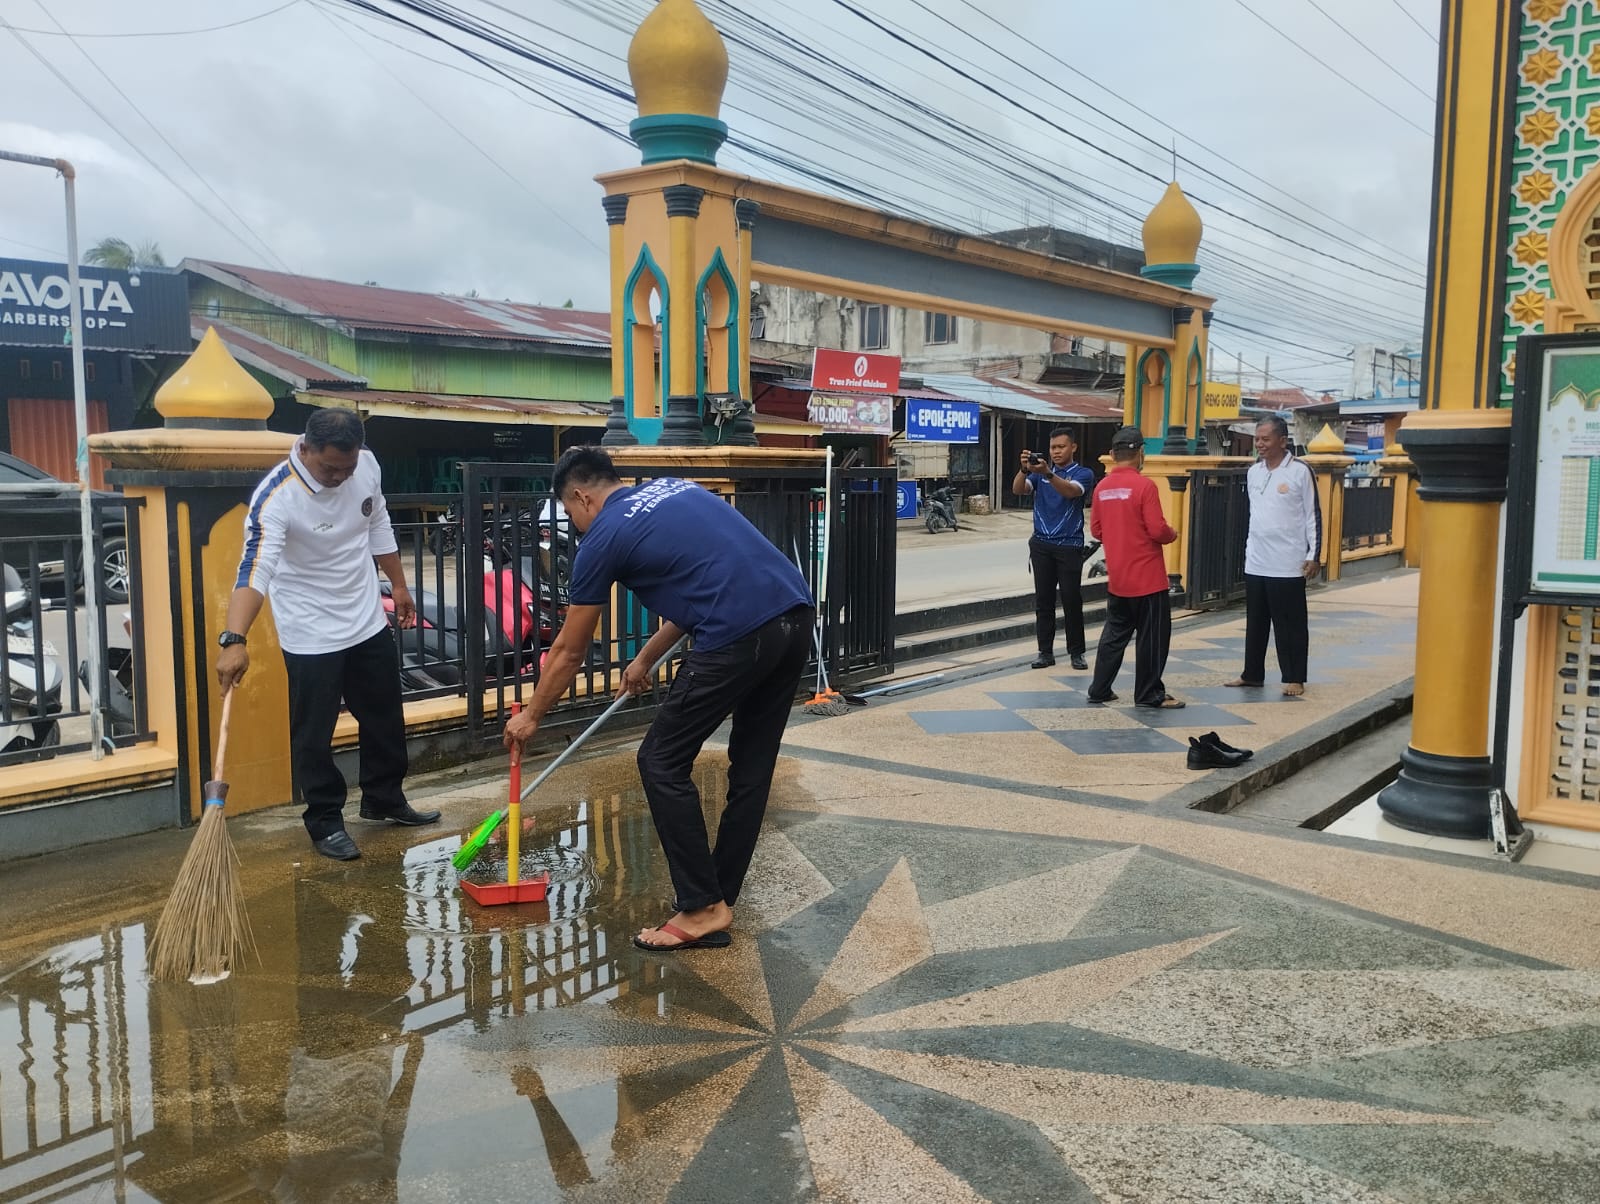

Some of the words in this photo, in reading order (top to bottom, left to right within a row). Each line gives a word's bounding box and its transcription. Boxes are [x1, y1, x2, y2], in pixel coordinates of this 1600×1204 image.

[0, 312, 107, 329] ARBERSOP
[845, 378, 862, 387] Fried
[863, 379, 888, 389] Chicken
[918, 408, 971, 428] EPOK-EPOK
